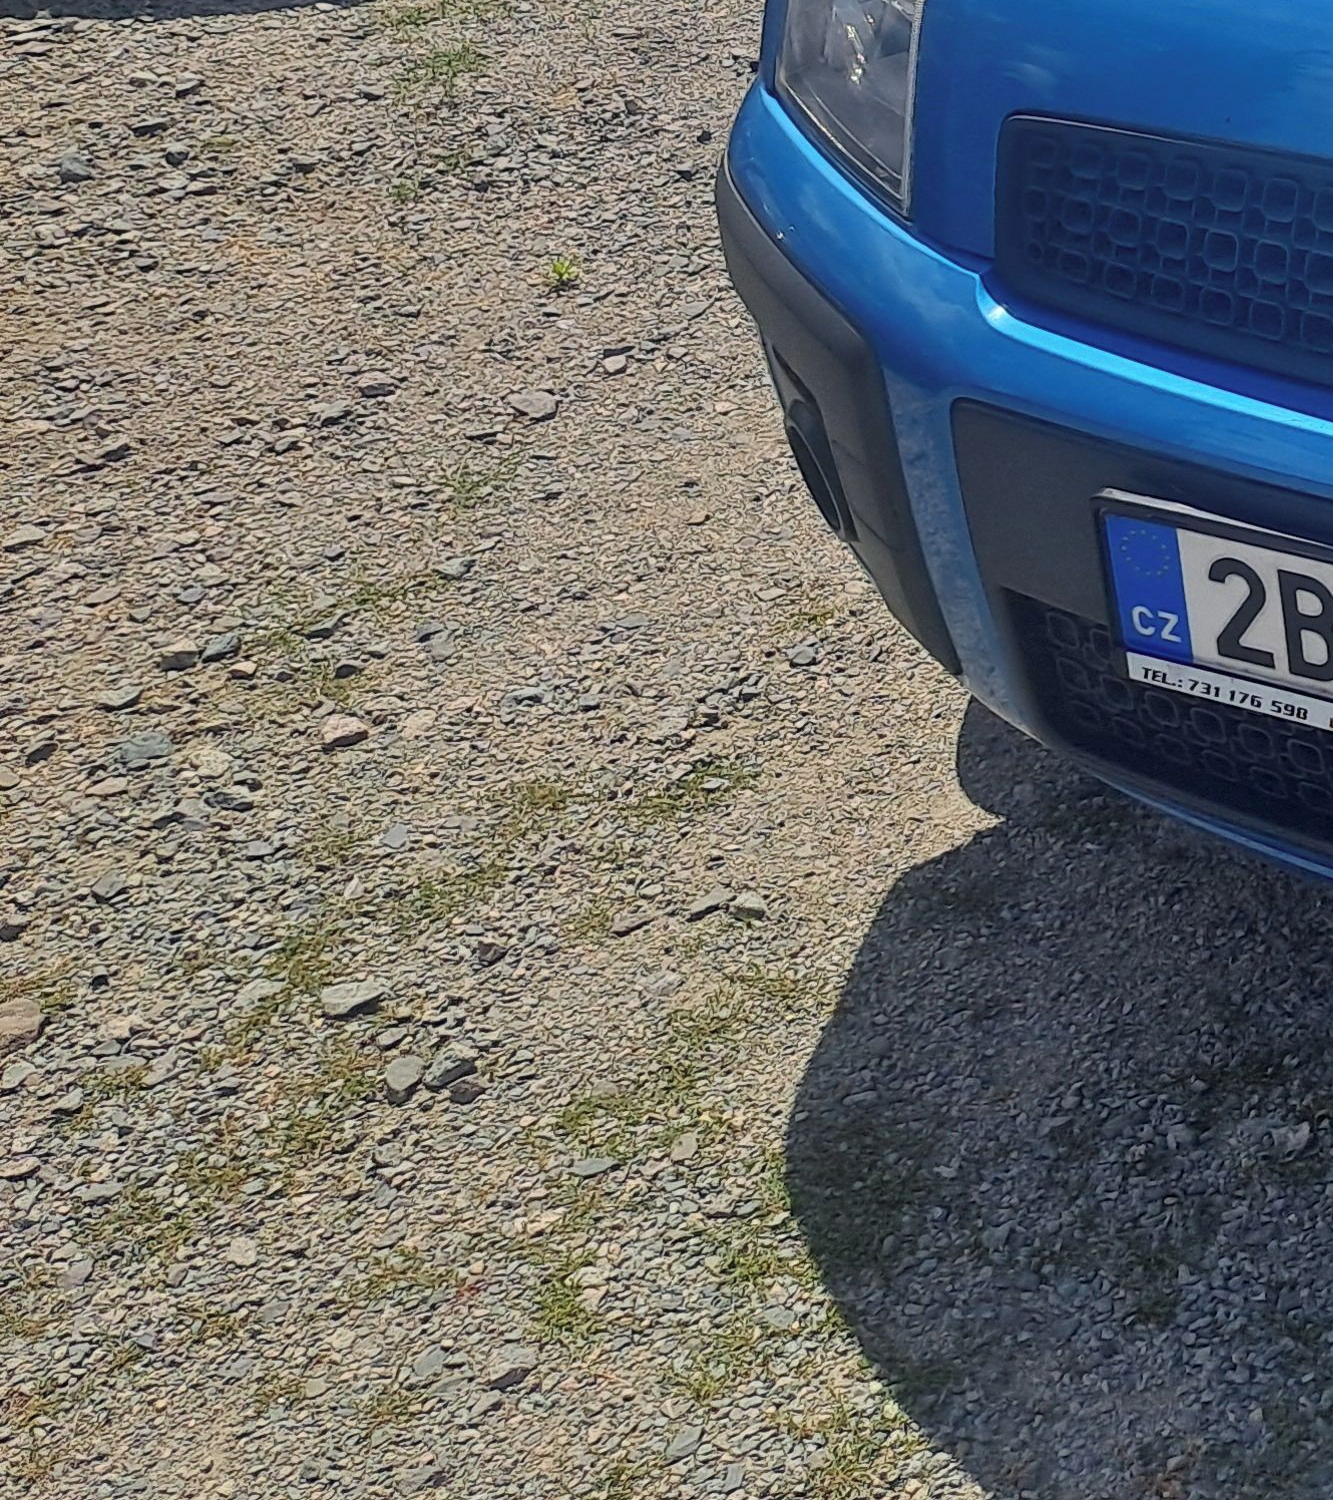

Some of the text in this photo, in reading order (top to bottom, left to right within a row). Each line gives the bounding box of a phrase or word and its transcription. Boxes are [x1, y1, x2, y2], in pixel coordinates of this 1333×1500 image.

[1131, 605, 1182, 643] CZ
[1142, 667, 1184, 689] TEL.:
[1188, 678, 1220, 699] 731
[1228, 689, 1262, 709] 176
[1269, 700, 1308, 720] 598
